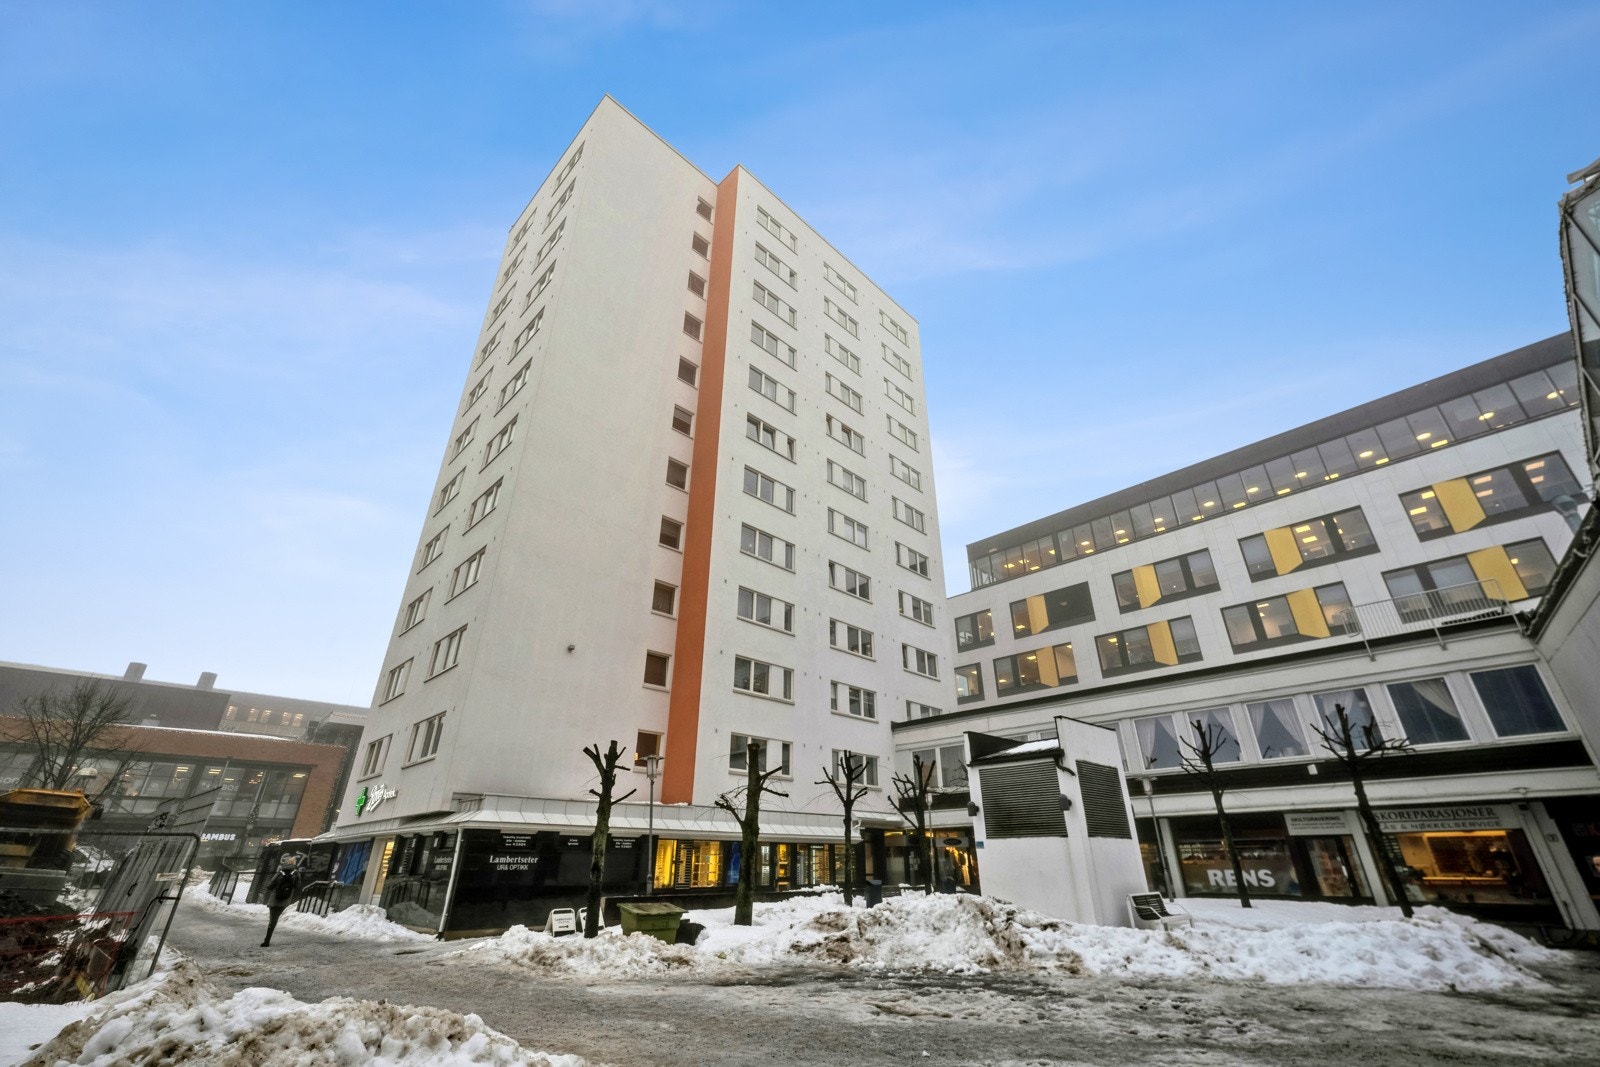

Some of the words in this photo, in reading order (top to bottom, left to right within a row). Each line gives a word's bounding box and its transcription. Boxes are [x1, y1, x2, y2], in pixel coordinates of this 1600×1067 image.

[1373, 807, 1496, 820] SKOREPARASJONER
[1410, 820, 1502, 830] NØKKELSERVICE
[489, 855, 539, 864] Lambertseter
[1207, 869, 1276, 888] RENS
